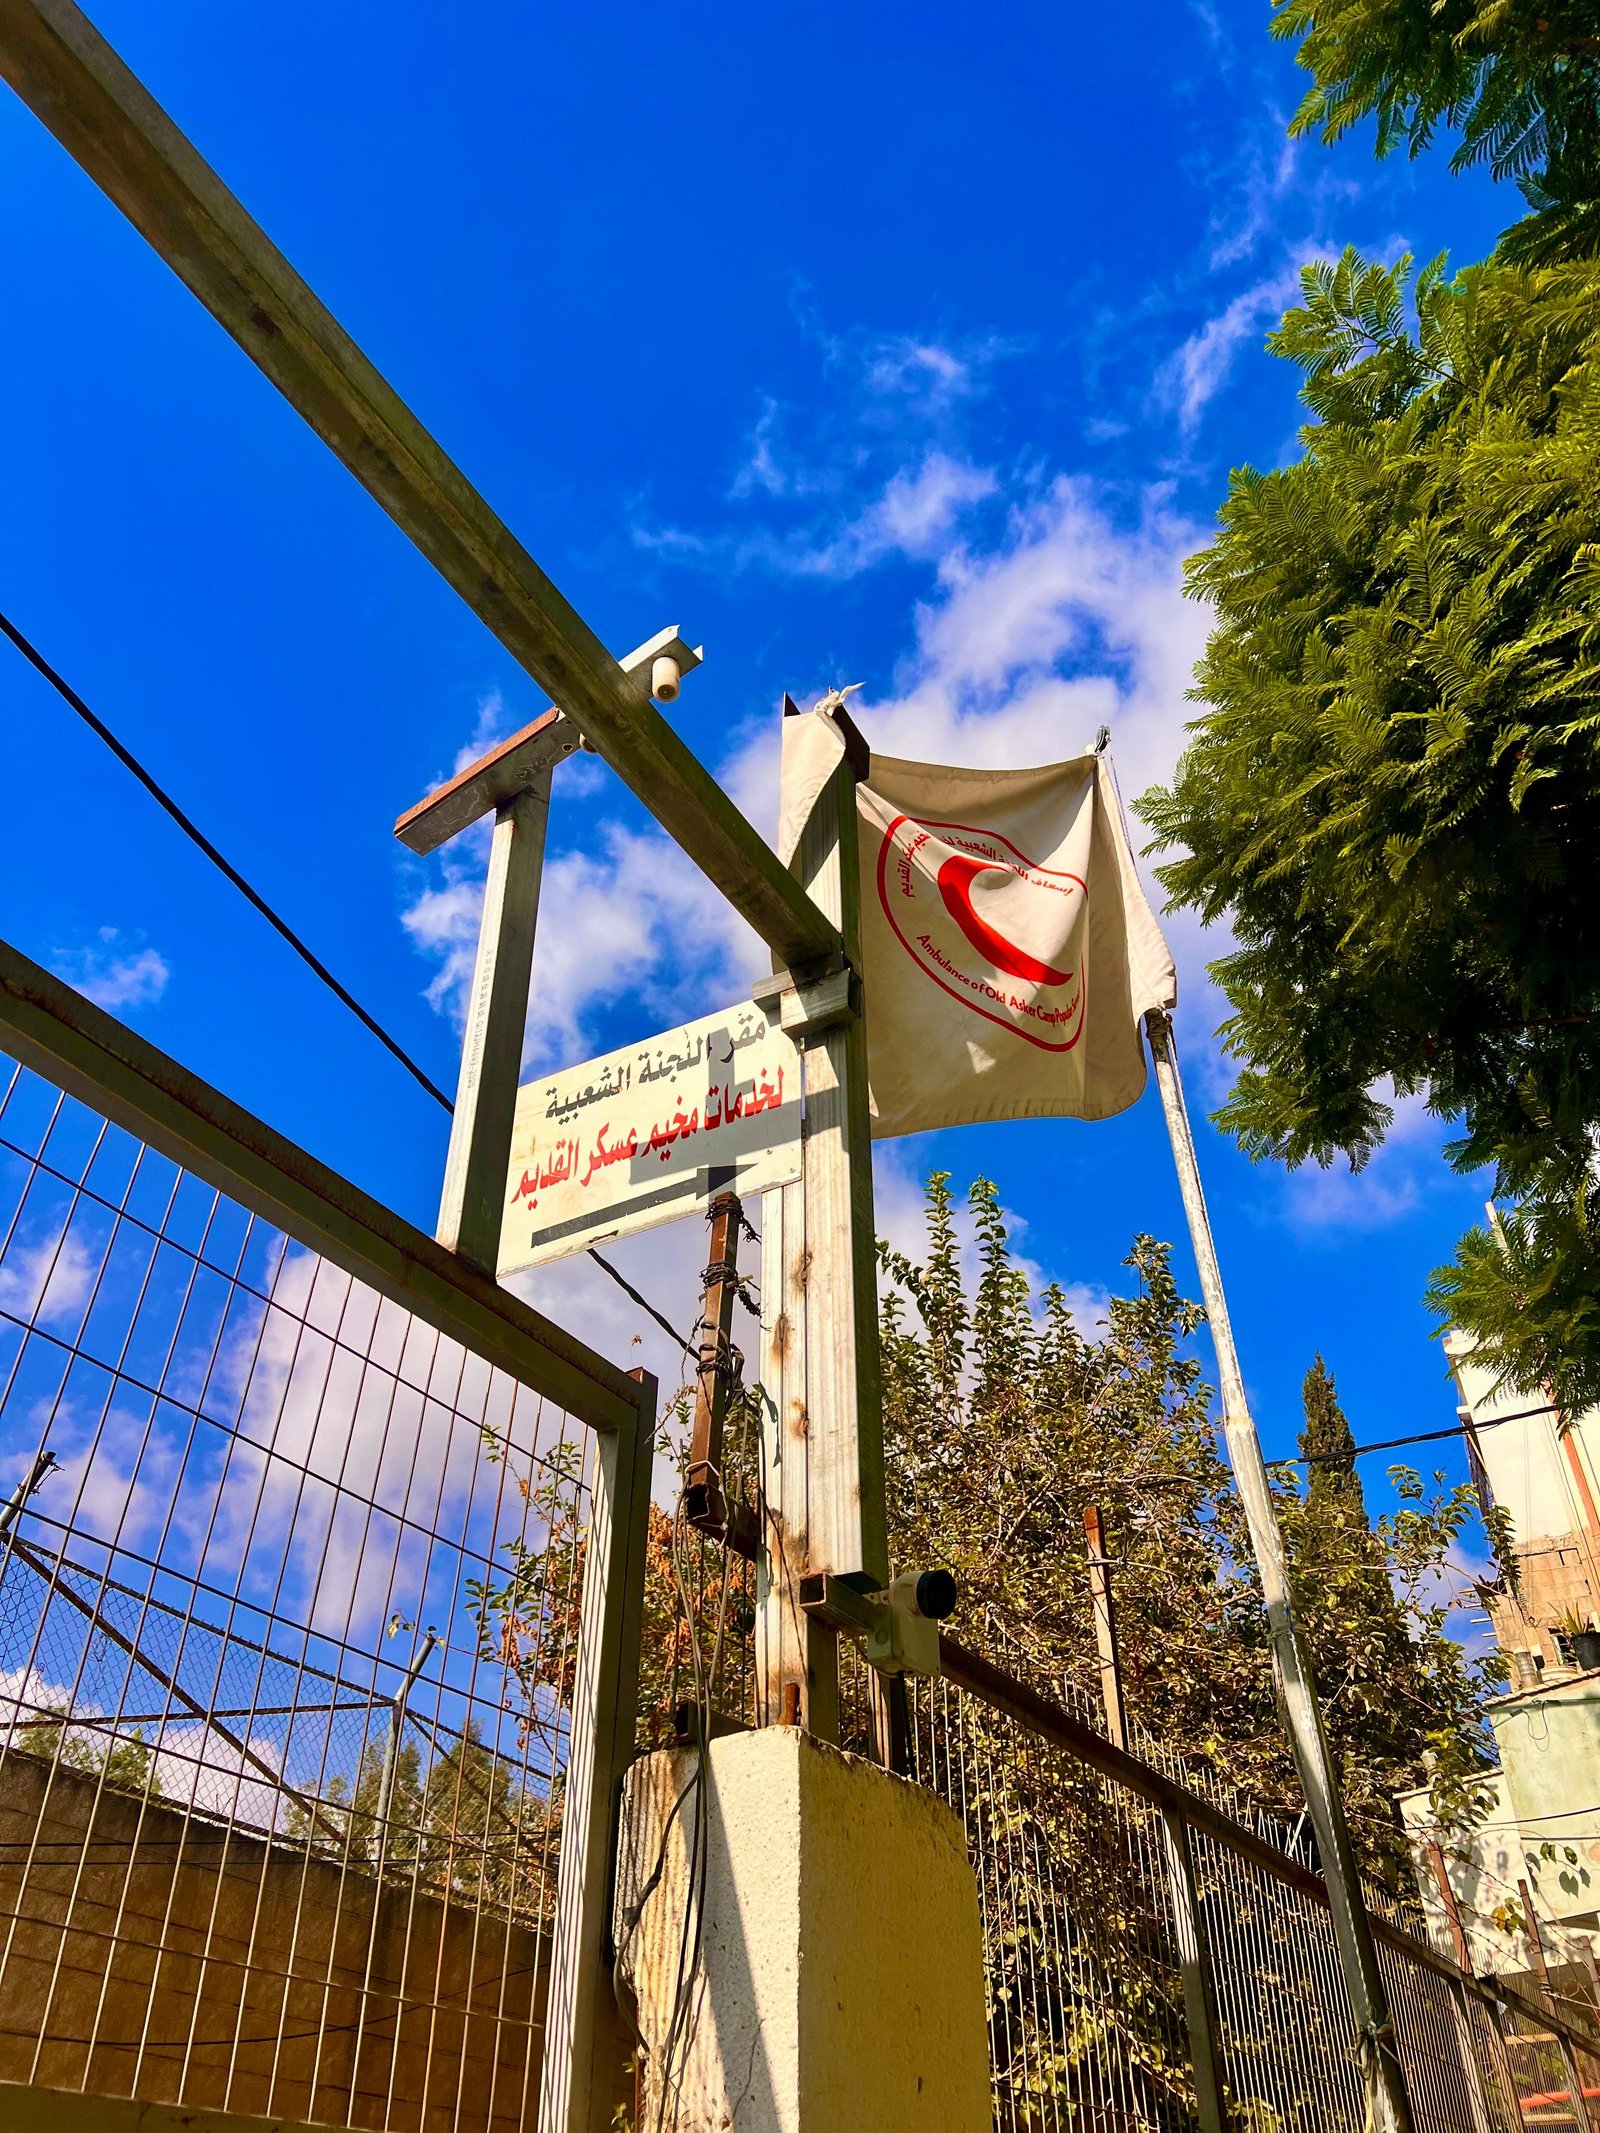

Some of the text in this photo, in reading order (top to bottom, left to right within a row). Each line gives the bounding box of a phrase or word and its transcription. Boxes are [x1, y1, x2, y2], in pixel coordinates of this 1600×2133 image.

[897, 859, 915, 897] القديم
[955, 836, 997, 860] الشعبية
[1031, 879, 1074, 896] إسعاف
[917, 935, 970, 985] Ambulance
[970, 977, 986, 993] of
[985, 986, 1006, 1004] Old
[1010, 995, 1036, 1017] Asker
[1037, 1005, 1056, 1027] Camp
[545, 1011, 766, 1125] مقر اللجنة الشعبية
[511, 1064, 785, 1211] لخدمات مخيم عسكر القديم
